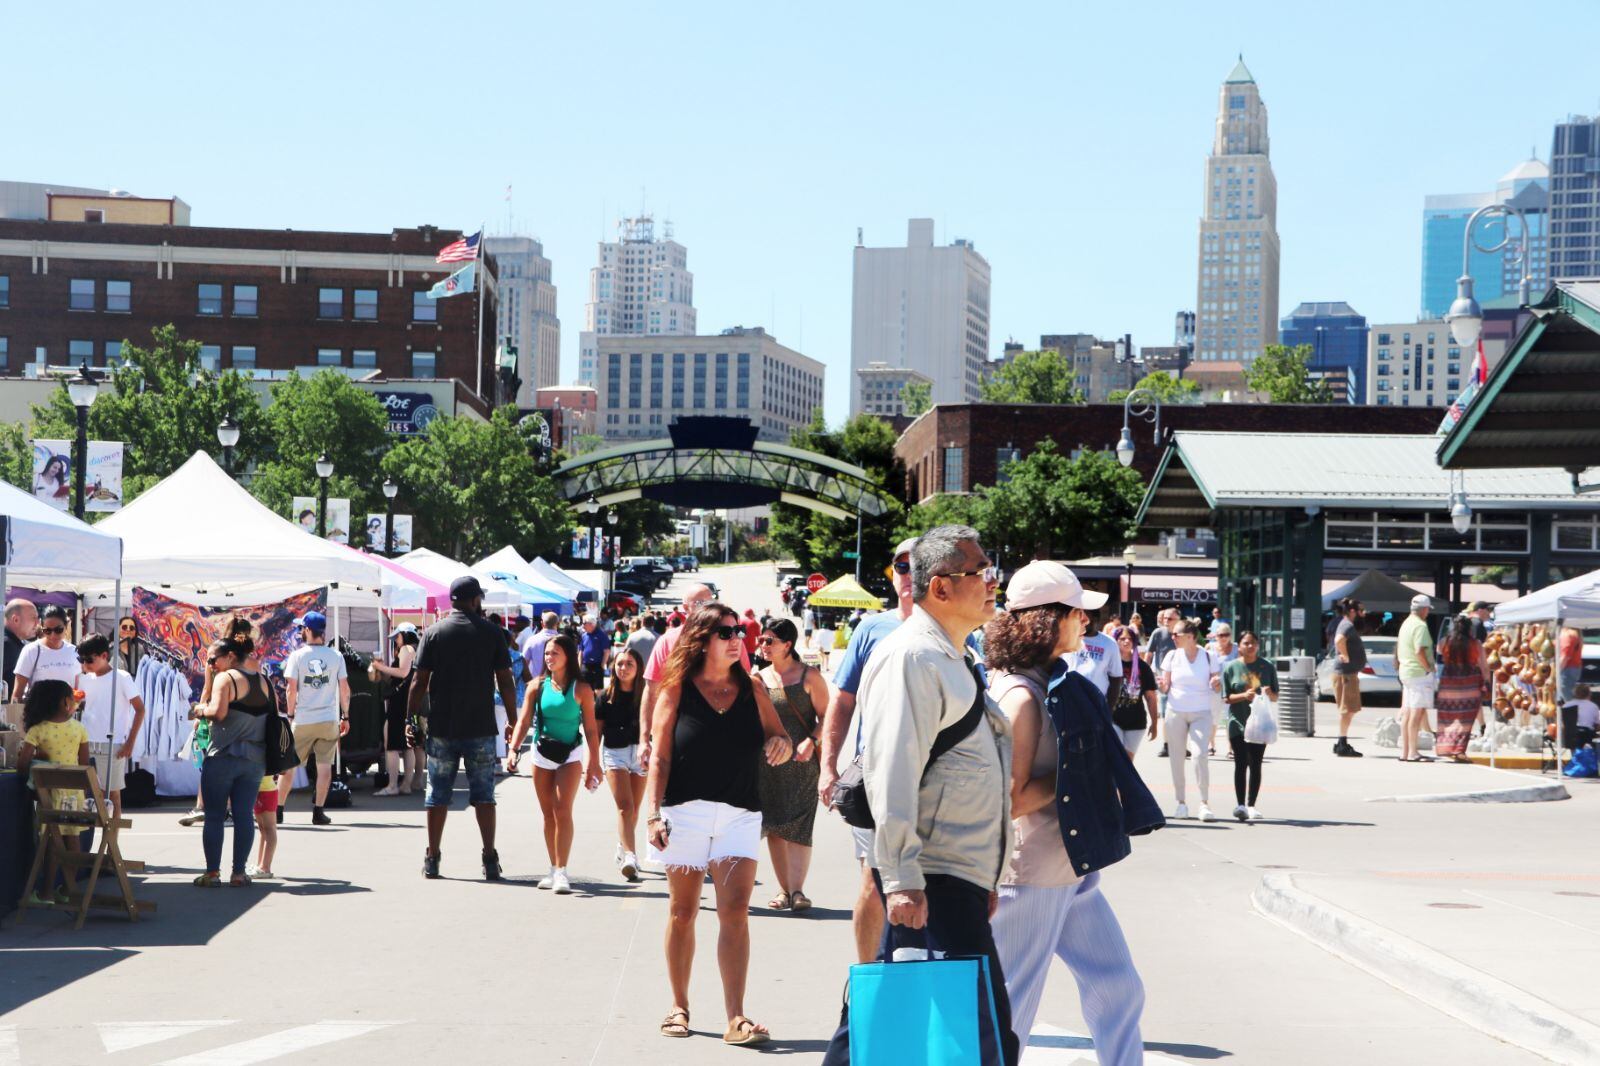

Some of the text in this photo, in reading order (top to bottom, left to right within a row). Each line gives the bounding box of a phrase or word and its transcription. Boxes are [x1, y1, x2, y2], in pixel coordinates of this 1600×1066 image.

[808, 580, 826, 588] STOP
[1172, 589, 1209, 602] ENZO
[815, 598, 872, 607] INFORMATION
